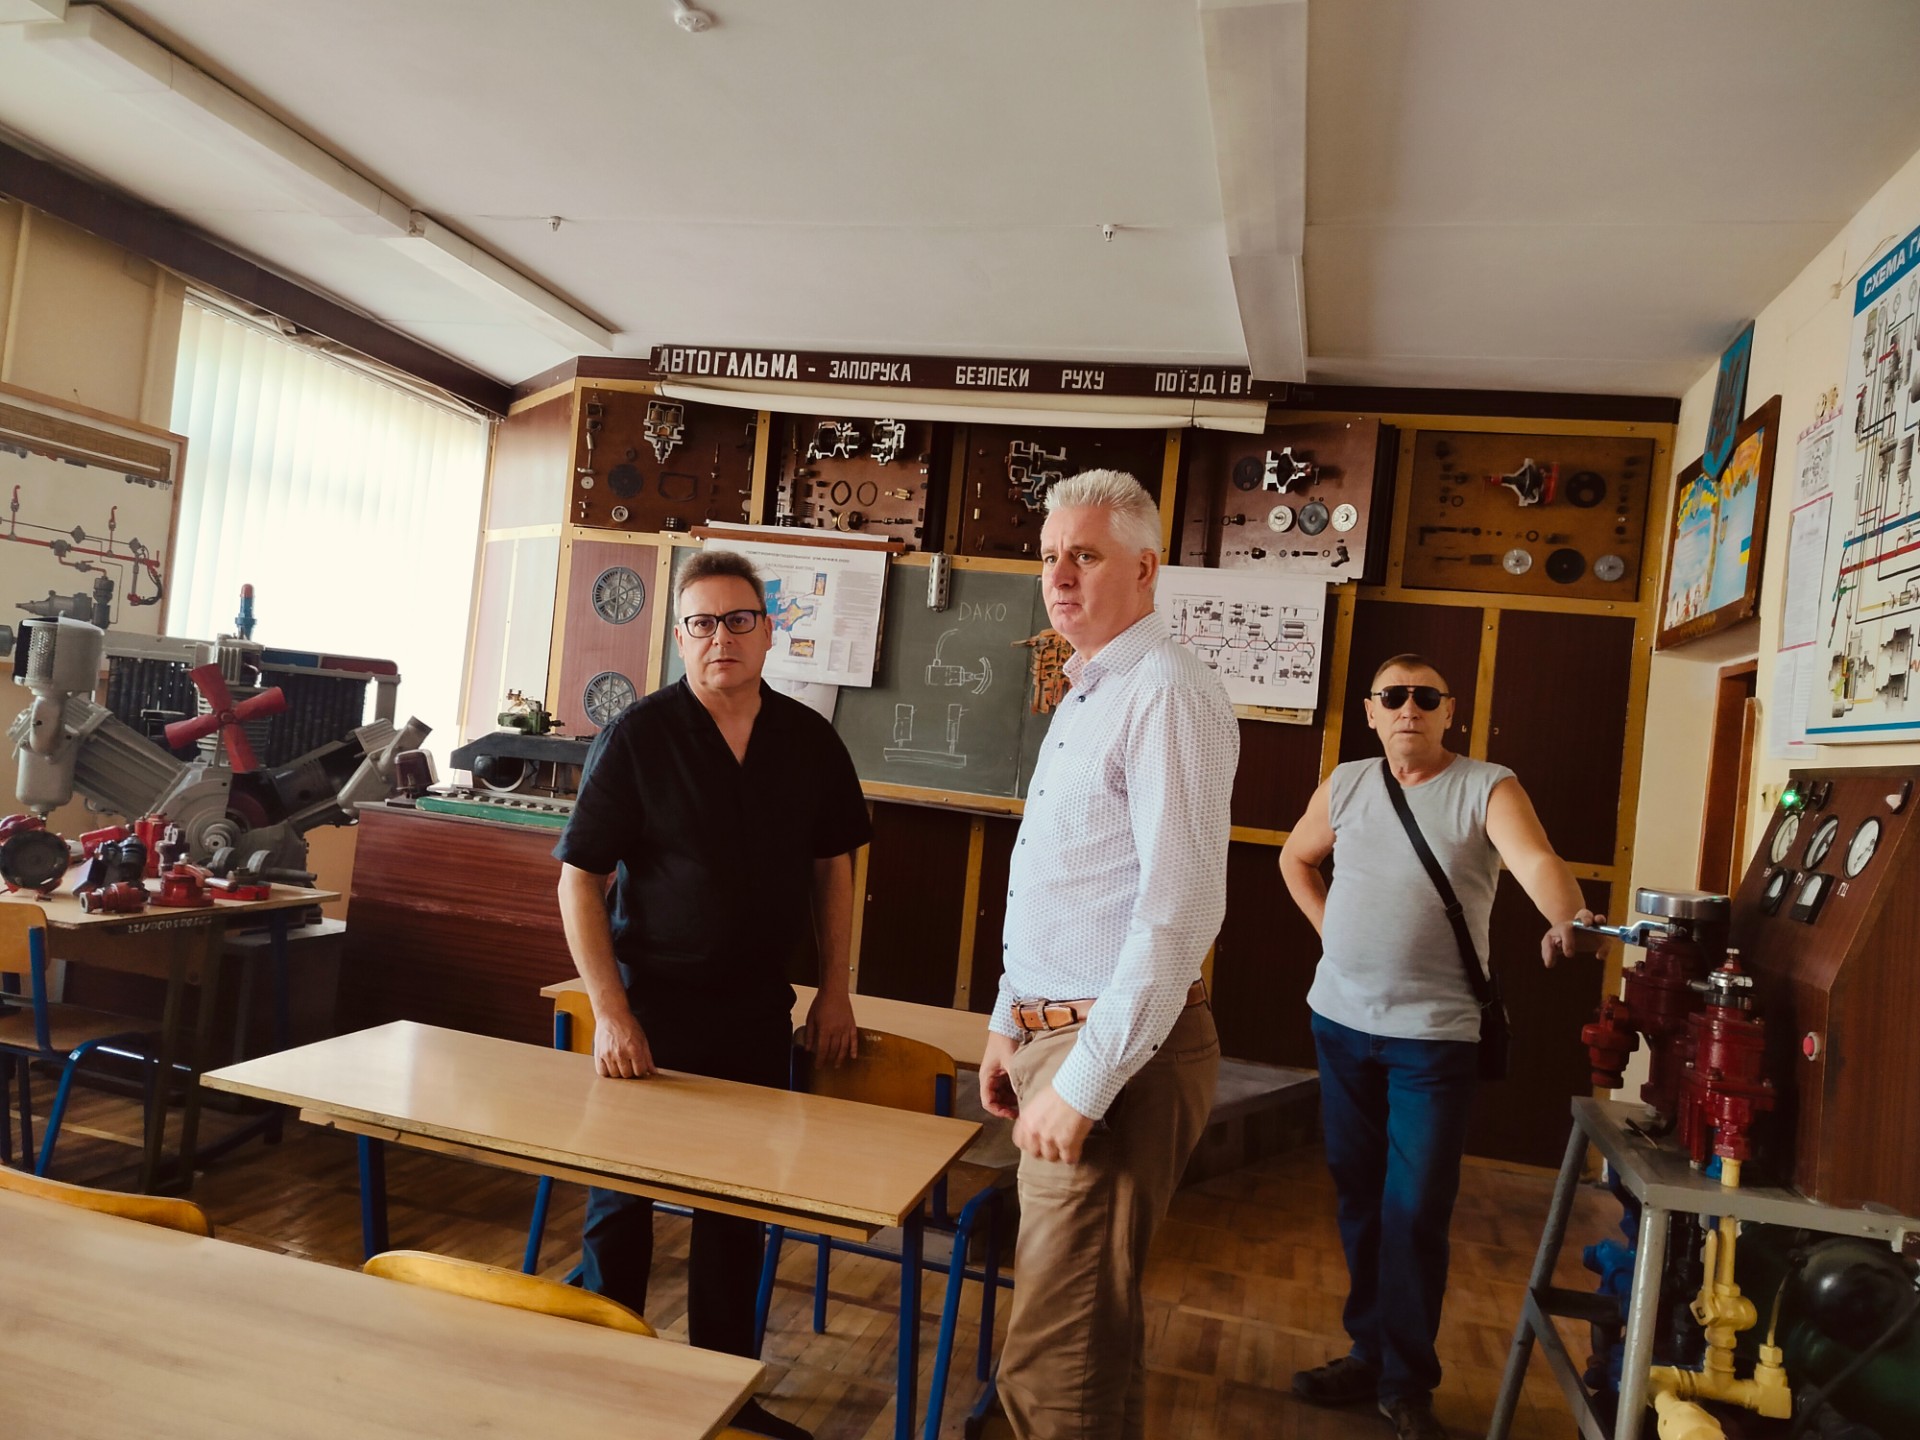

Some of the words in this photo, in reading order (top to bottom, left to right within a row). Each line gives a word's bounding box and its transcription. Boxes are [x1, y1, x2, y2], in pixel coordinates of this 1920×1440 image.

[1863, 247, 1906, 298] СХЕМА
[657, 347, 799, 380] АВТОГАЛЬМА
[829, 359, 912, 383] ЗАПОРУКА
[955, 365, 1030, 388] БЕЗПЕКИ
[1060, 369, 1105, 390] РУХУ
[1154, 369, 1252, 395] ПОЇЗДІВ!
[958, 602, 1007, 622] DAKO
